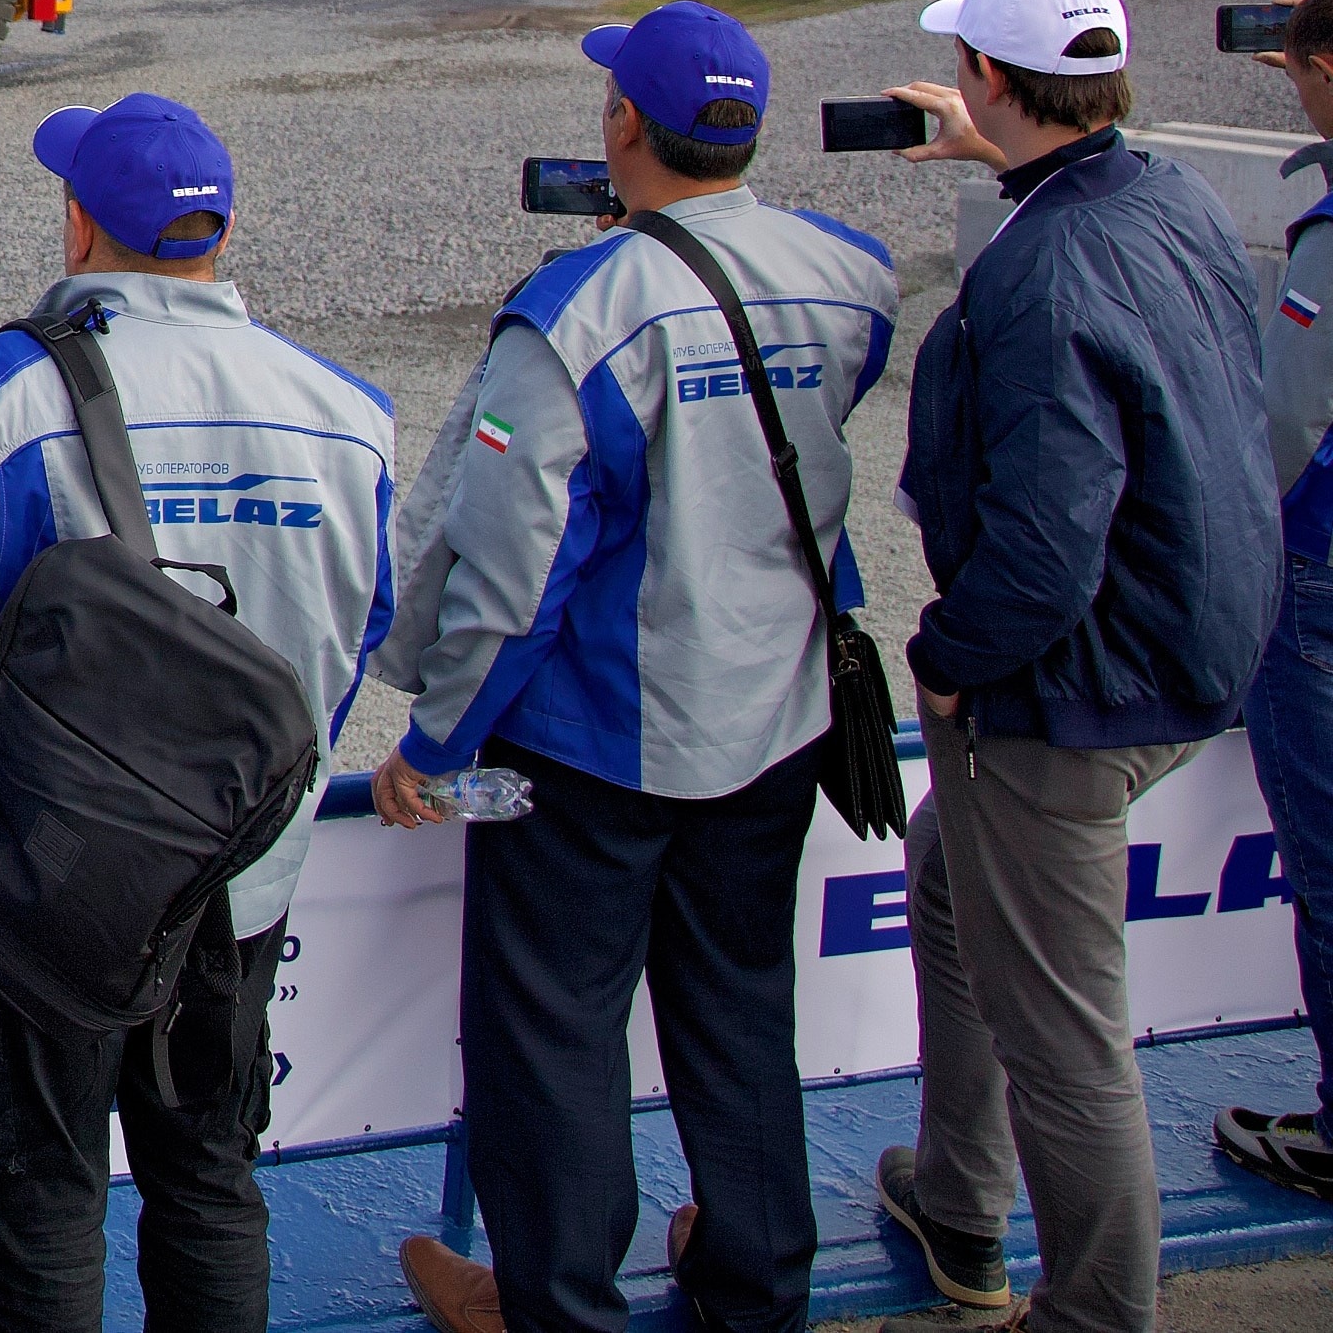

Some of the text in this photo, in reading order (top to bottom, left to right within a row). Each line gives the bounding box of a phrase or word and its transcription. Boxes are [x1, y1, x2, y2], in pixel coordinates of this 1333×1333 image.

[1062, 7, 1110, 19] BELAZ
[705, 75, 754, 88] BELAZ
[172, 185, 219, 198] BELAZ
[698, 340, 736, 356] ОПЕРАТ
[137, 462, 230, 475] УБ ОПЕРАТОРОВ
